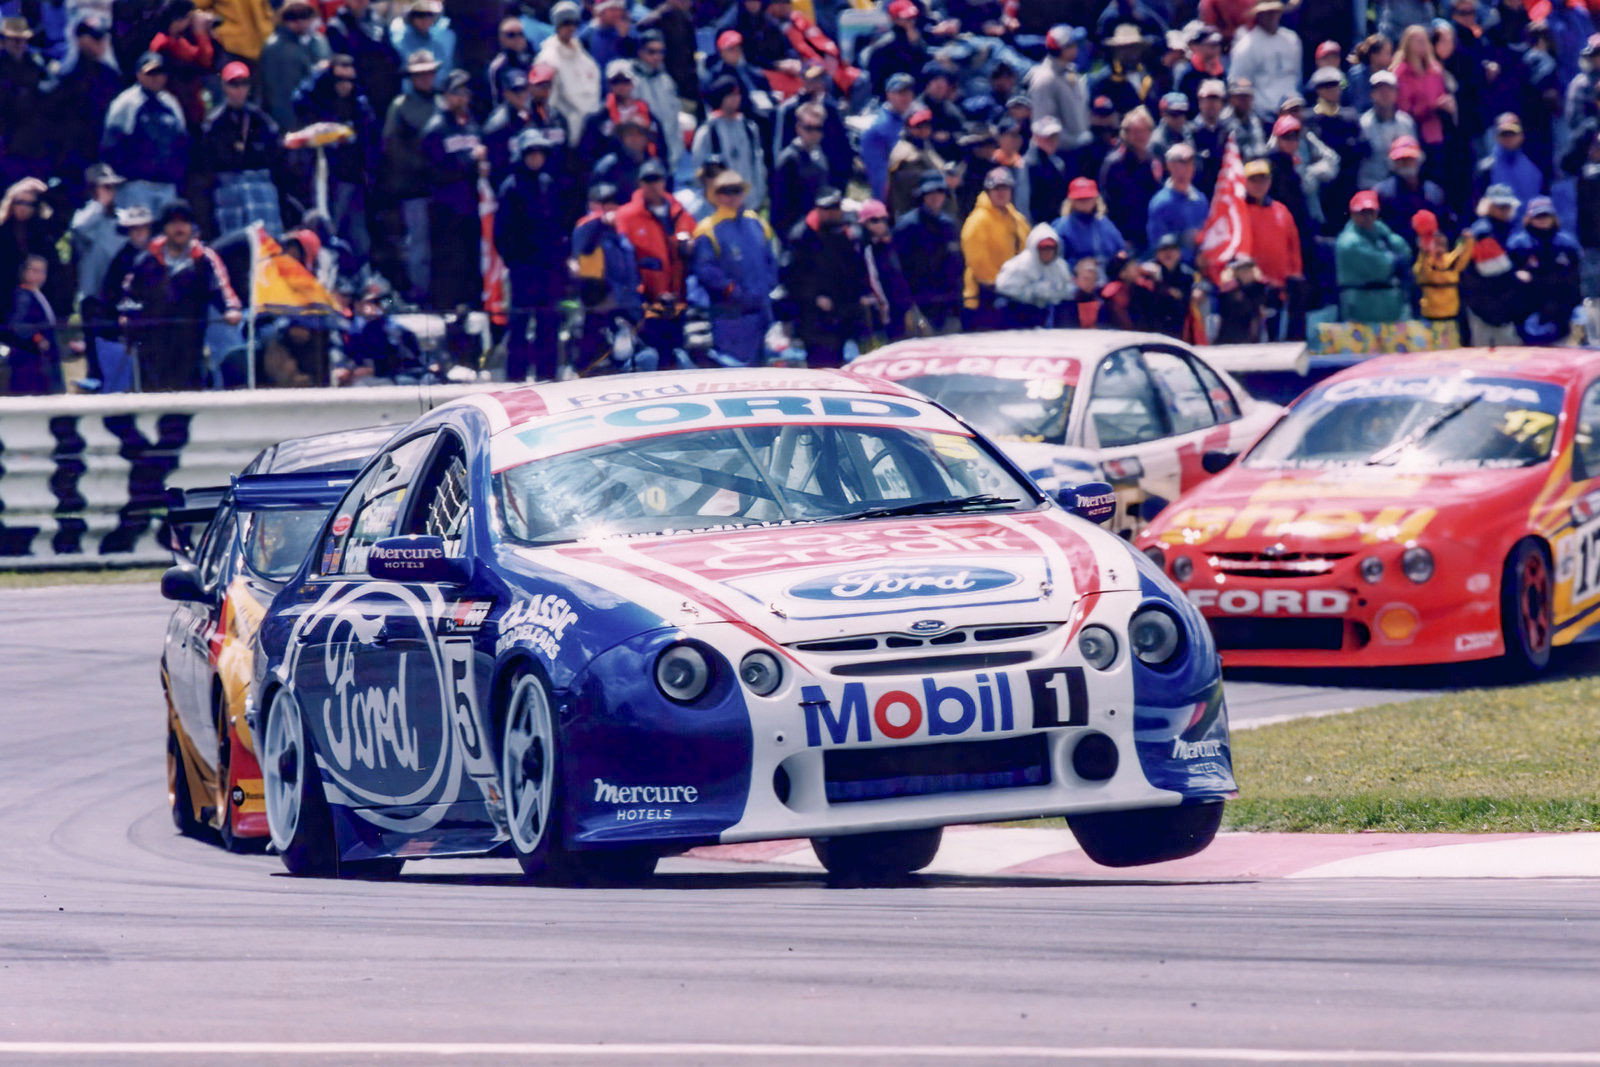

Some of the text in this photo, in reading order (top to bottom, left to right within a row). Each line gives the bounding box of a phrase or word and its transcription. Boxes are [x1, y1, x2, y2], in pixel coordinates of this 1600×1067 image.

[852, 356, 1070, 380] HOLDEN
[567, 384, 689, 407] Ford
[513, 397, 921, 449] FORD
[369, 542, 443, 559] Mercure
[704, 531, 1024, 570] Credit
[710, 524, 954, 550] Ford
[384, 561, 425, 569] HOTELS
[830, 568, 977, 598] Ford
[1182, 589, 1351, 615] FORD
[498, 593, 579, 641] CLASSIC
[324, 607, 419, 772] Ford
[450, 657, 486, 761] 5
[799, 672, 1072, 748] Mobil 1
[593, 777, 699, 804] Mercure
[616, 808, 672, 821] HOTELS
